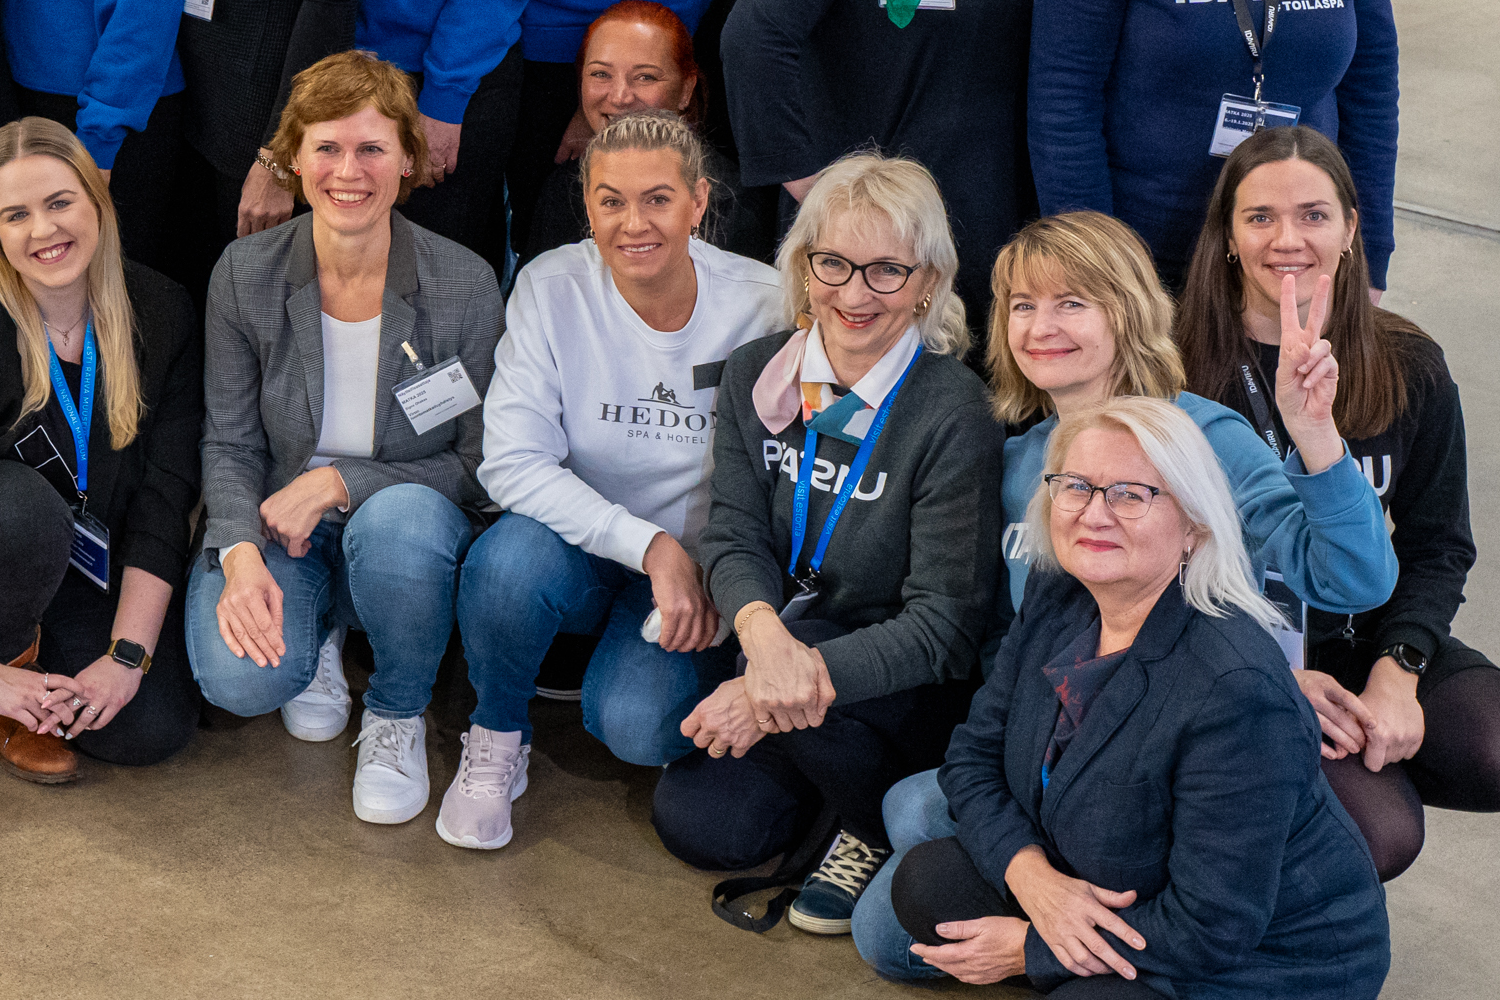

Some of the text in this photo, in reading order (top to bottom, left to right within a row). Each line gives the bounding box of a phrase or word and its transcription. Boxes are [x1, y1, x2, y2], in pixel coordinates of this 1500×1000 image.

[1267, 5, 1275, 32] IDAVIRU
[1244, 29, 1259, 57] IDAVIRU
[1224, 118, 1254, 126] 6.-19.1.2025
[83, 366, 92, 394] RAHVA
[59, 388, 78, 426] NATIONAL
[75, 426, 87, 461] MUSEUM
[81, 396, 89, 432] MUUSE
[869, 390, 898, 444] visit estonia
[627, 430, 706, 444] SPA & HOTEL
[762, 439, 888, 501] PÄRNU
[794, 480, 805, 537] visit estonia
[825, 483, 853, 535] visit estonia
